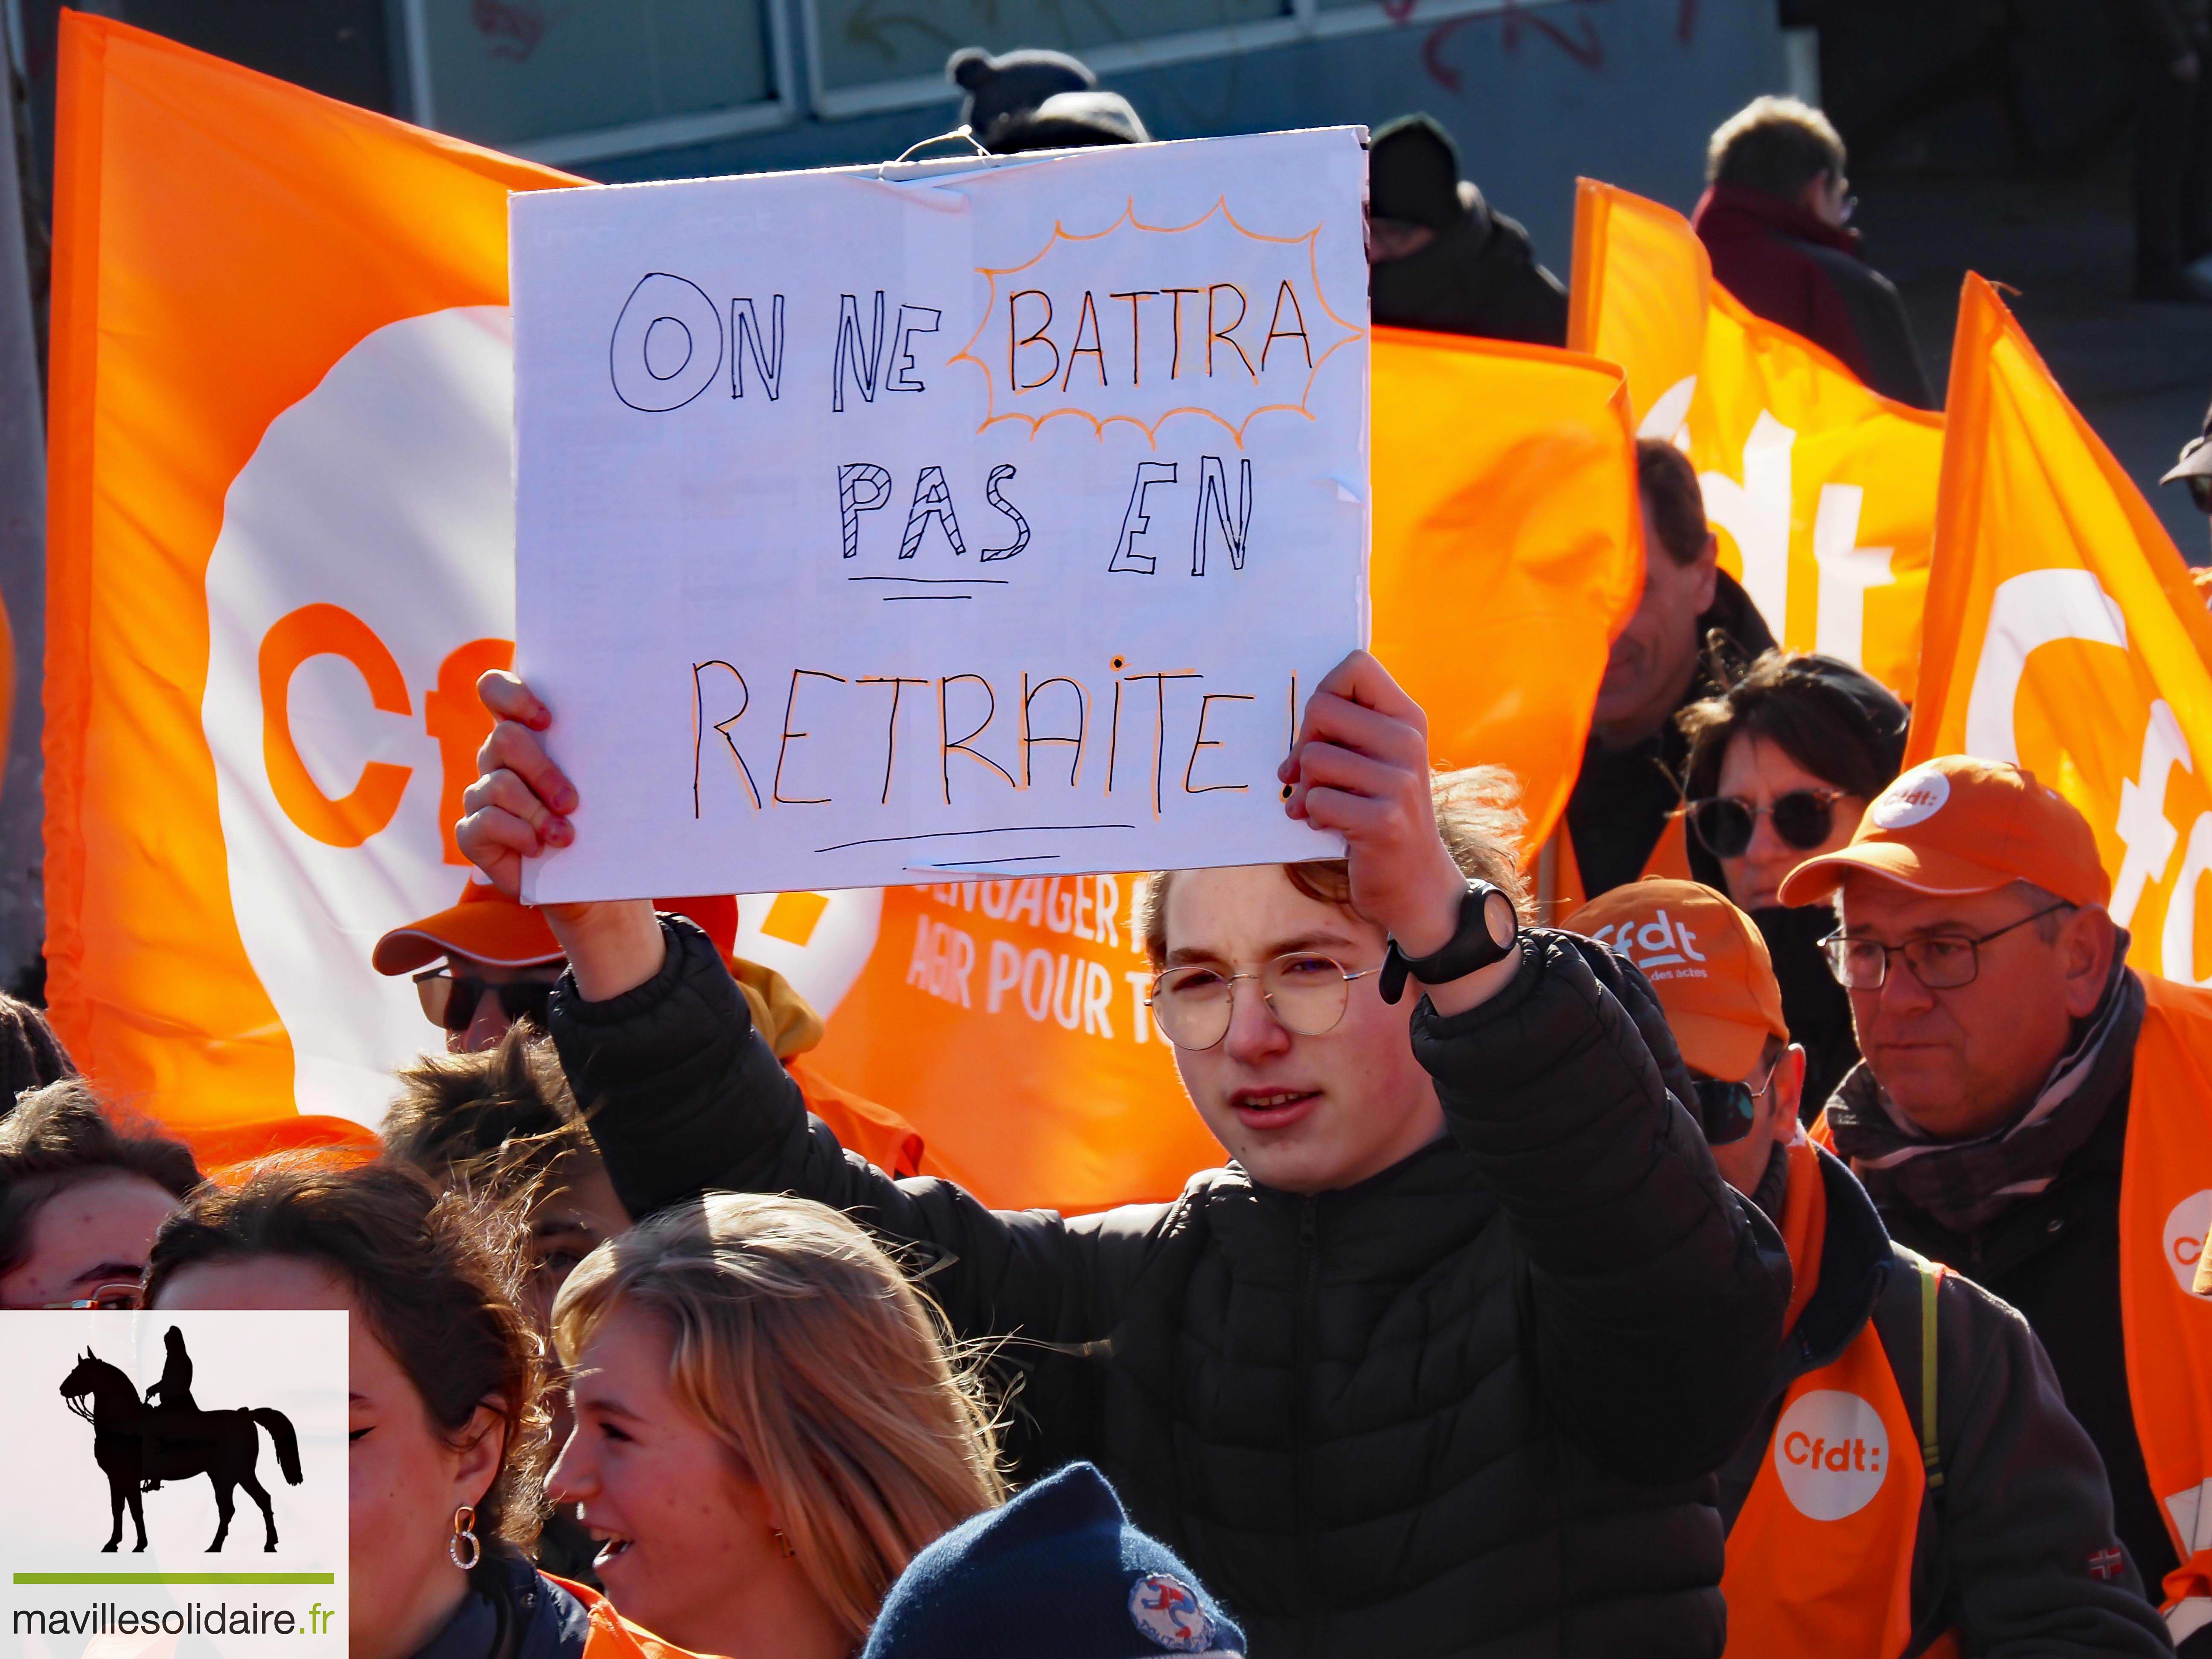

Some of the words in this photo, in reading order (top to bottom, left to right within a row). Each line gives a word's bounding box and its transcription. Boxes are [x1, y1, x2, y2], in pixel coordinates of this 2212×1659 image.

[610, 272, 784, 412] ON
[832, 290, 942, 412] NE
[1008, 279, 1313, 395] BATTRA
[837, 463, 1030, 562] PAS
[1108, 456, 1252, 576] EN
[986, 940, 1115, 1039] POUR
[1125, 970, 1174, 1048] T
[1676, 968, 1707, 979] actes
[1784, 1431, 1880, 1472] Cfdt:
